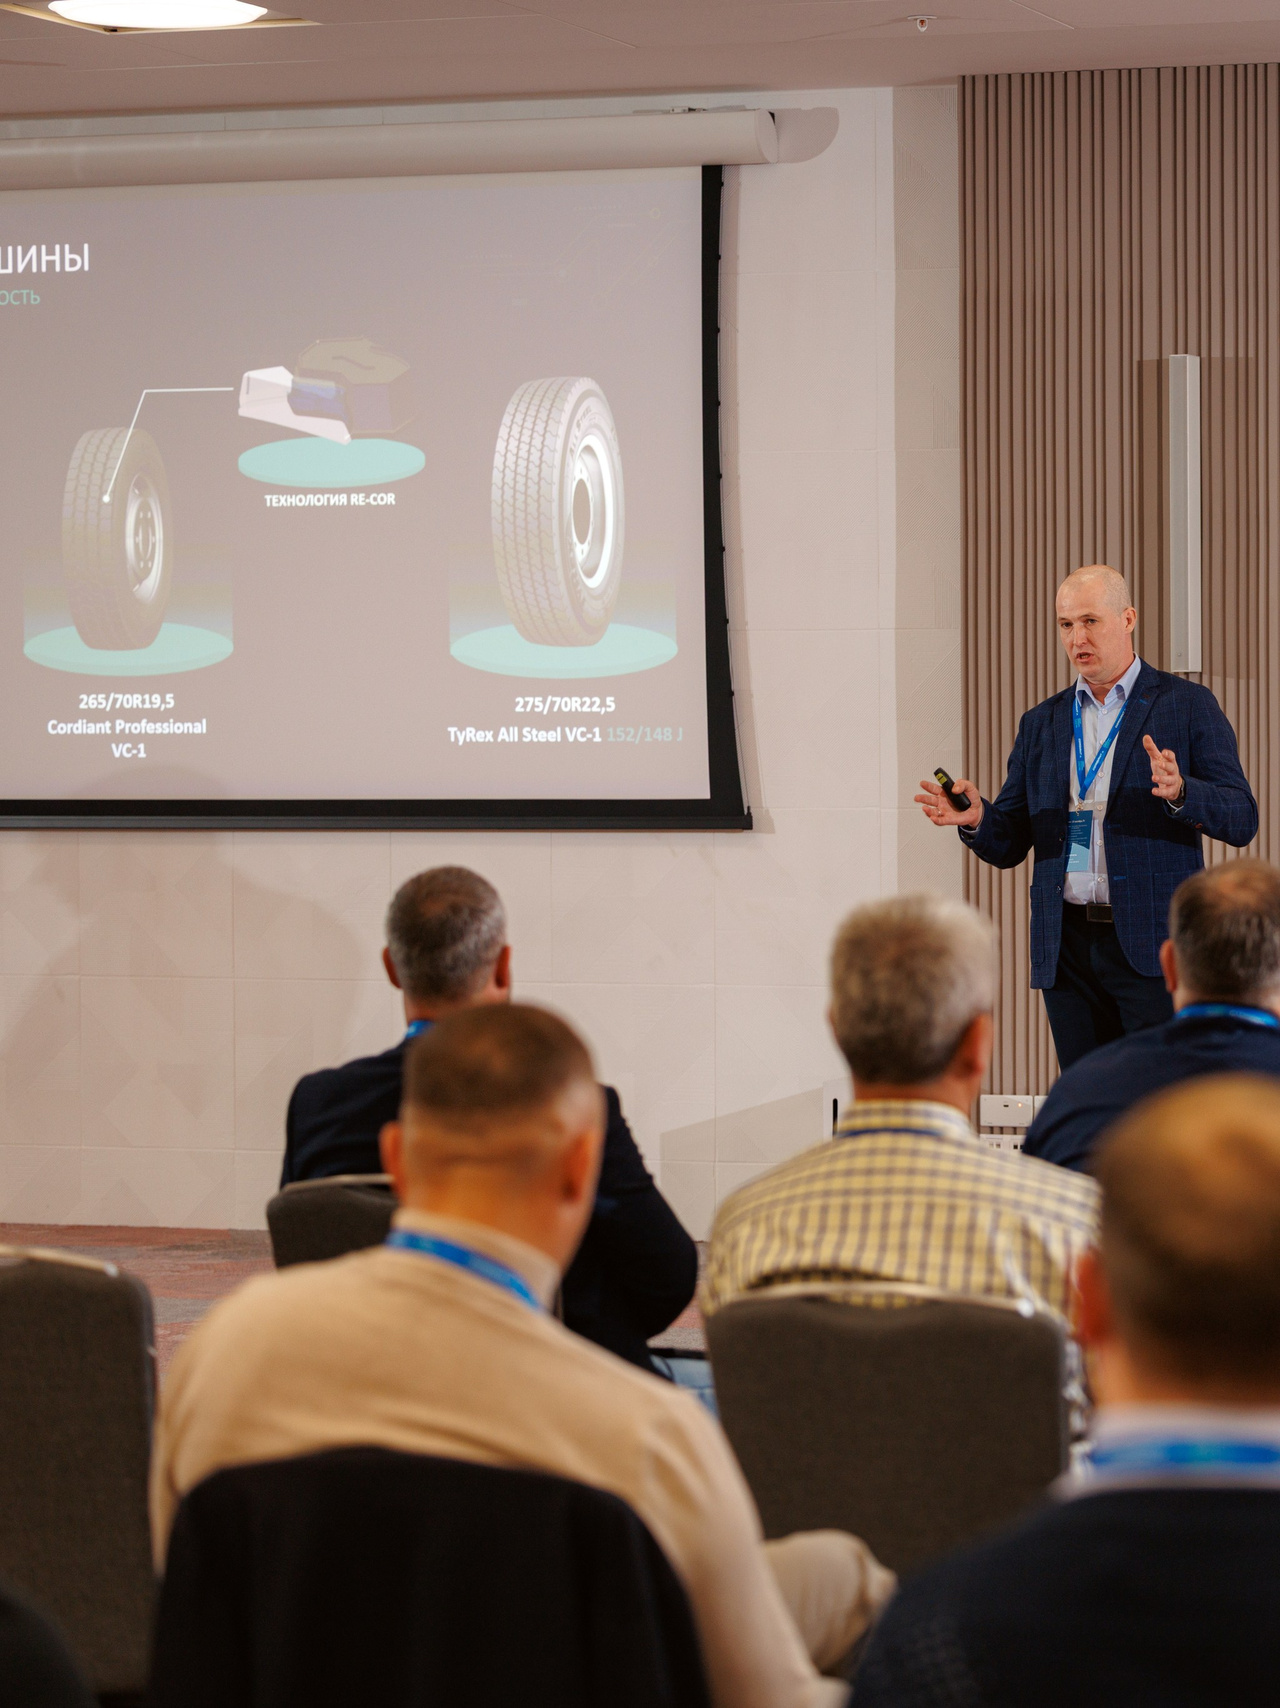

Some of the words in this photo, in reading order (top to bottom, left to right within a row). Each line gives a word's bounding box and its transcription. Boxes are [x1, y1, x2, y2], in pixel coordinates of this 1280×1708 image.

[264, 493, 347, 507] ТЕХНОЛОГИЯ
[350, 493, 396, 507] RE-COR
[78, 692, 175, 712] 265/70R19,5
[514, 695, 616, 715] 275/70R22,5
[47, 719, 112, 735] Cordiant
[115, 718, 207, 735] Professional
[447, 727, 494, 746] TyRex
[497, 726, 519, 742] All
[522, 726, 562, 742] Steel
[564, 726, 602, 743] VC-1
[606, 725, 673, 745] 152/148
[111, 743, 147, 758] VC-1
